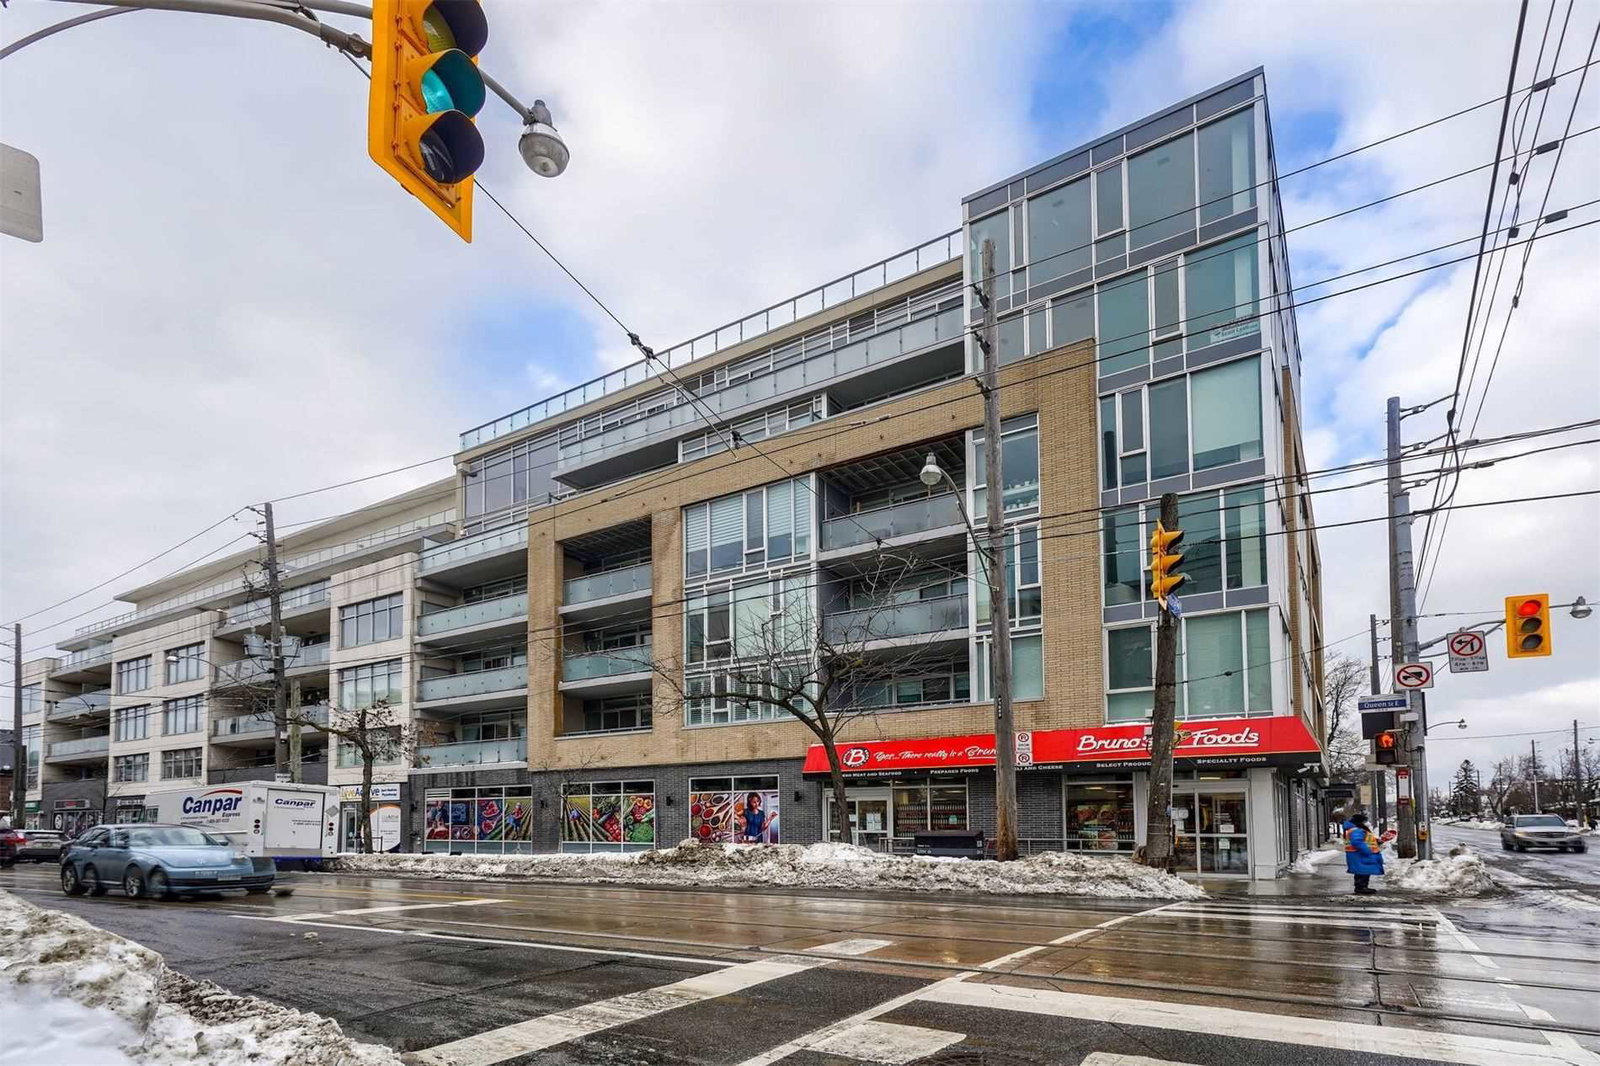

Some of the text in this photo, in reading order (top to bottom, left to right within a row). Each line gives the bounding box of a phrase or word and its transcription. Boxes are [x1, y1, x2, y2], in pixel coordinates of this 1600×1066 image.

[1364, 701, 1387, 709] Queen
[1190, 727, 1260, 746] Foods
[964, 745, 998, 757] Brun
[183, 796, 242, 815] Canpar
[275, 798, 316, 807] Canpar
